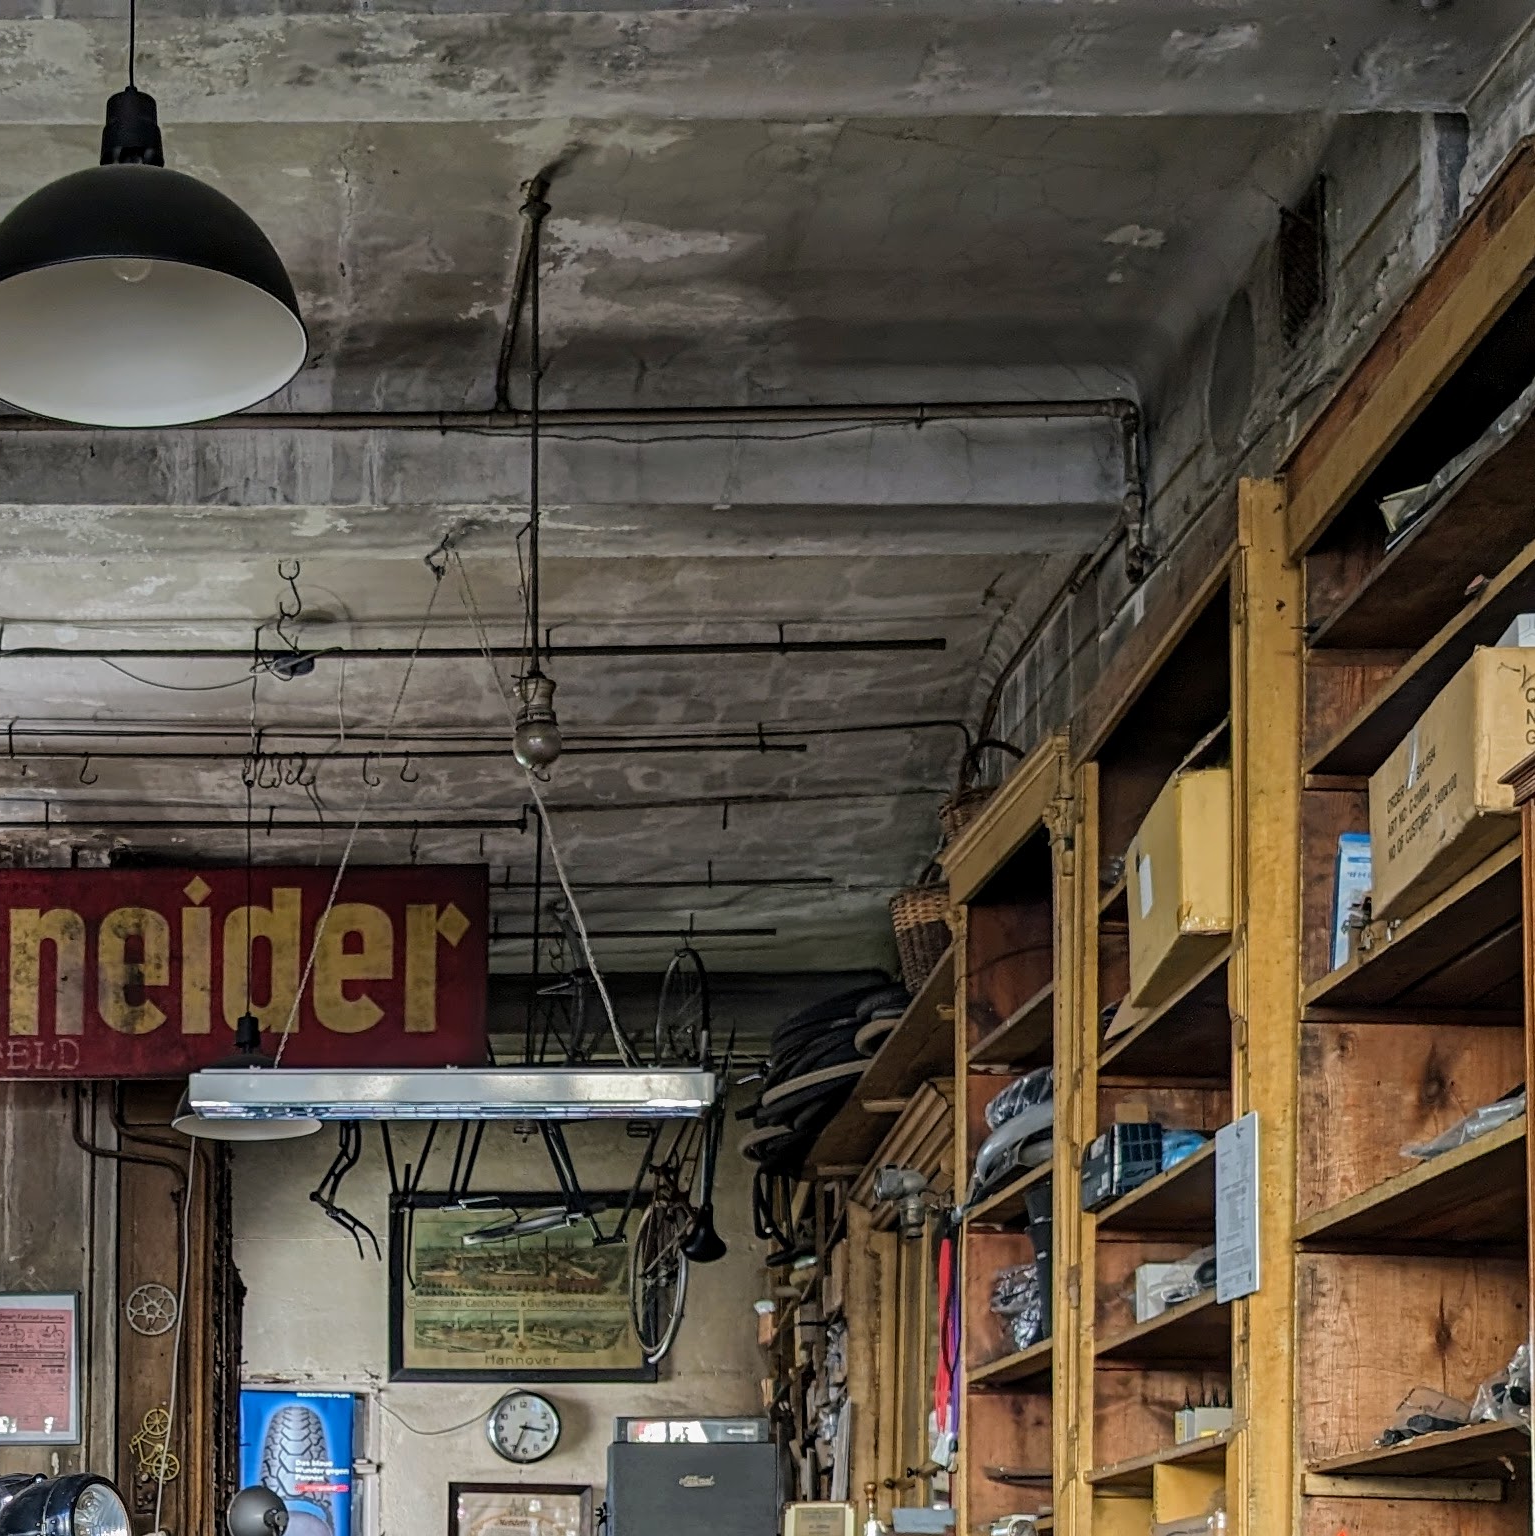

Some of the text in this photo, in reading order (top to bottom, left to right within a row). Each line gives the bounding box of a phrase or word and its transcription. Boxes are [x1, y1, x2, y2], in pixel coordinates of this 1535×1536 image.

[484, 1355, 559, 1365] Hannover
[295, 1466, 349, 1476] Wunder gegen
